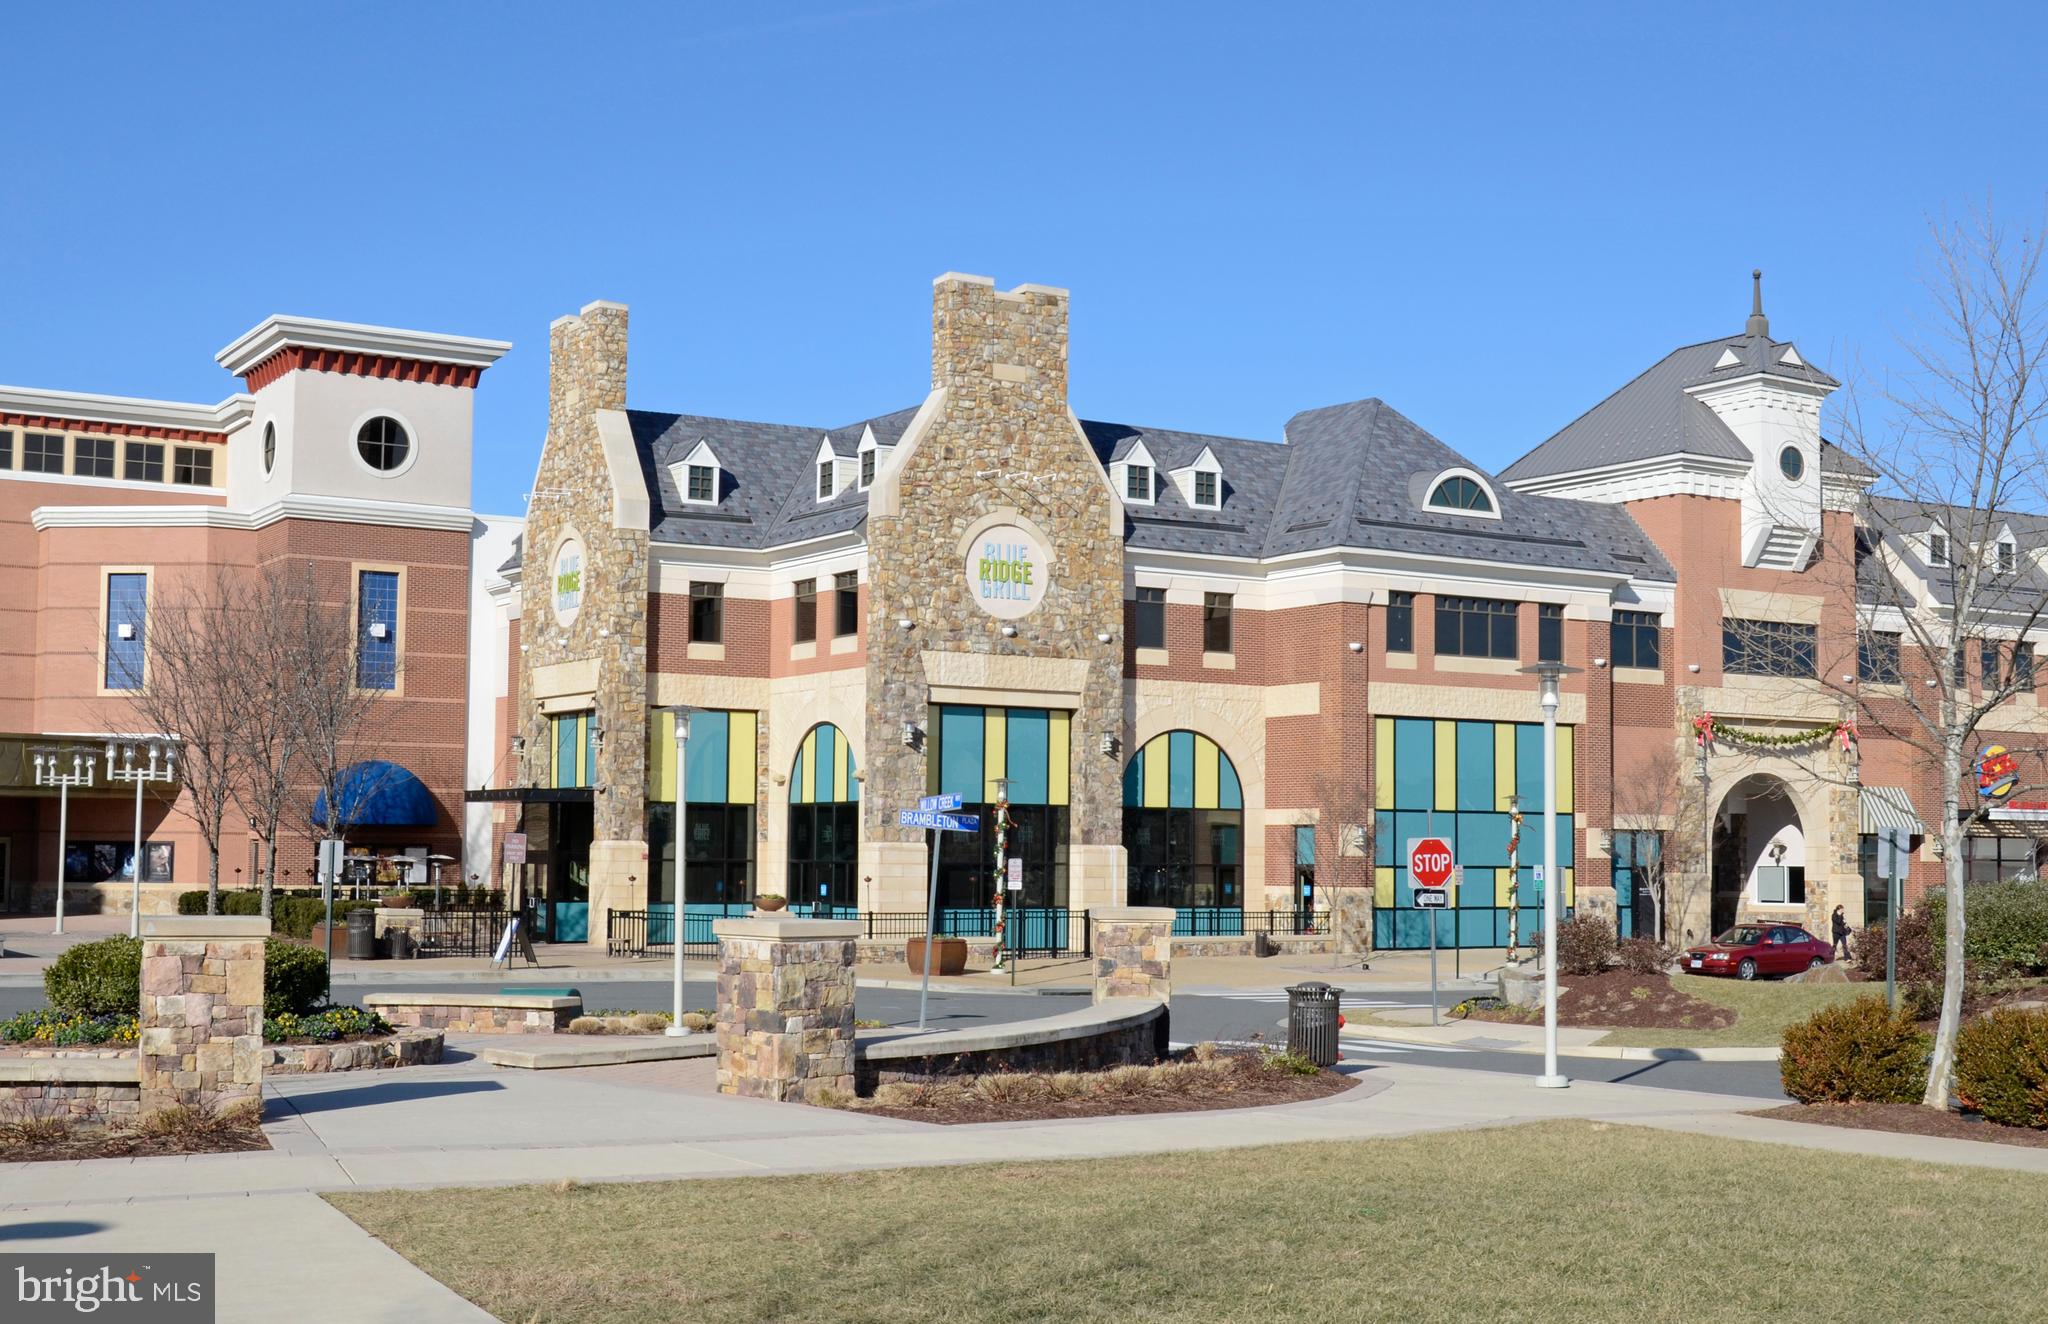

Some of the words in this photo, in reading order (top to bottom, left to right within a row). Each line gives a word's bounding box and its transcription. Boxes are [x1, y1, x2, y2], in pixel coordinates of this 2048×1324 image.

[983, 543, 1028, 562] BLUE
[978, 558, 1033, 585] RIDGE
[981, 578, 1031, 601] GRILL
[938, 795, 954, 810] CREEK
[901, 811, 959, 829] BRAMBLETON
[961, 816, 977, 825] PLAZA
[1414, 853, 1450, 873] STOP
